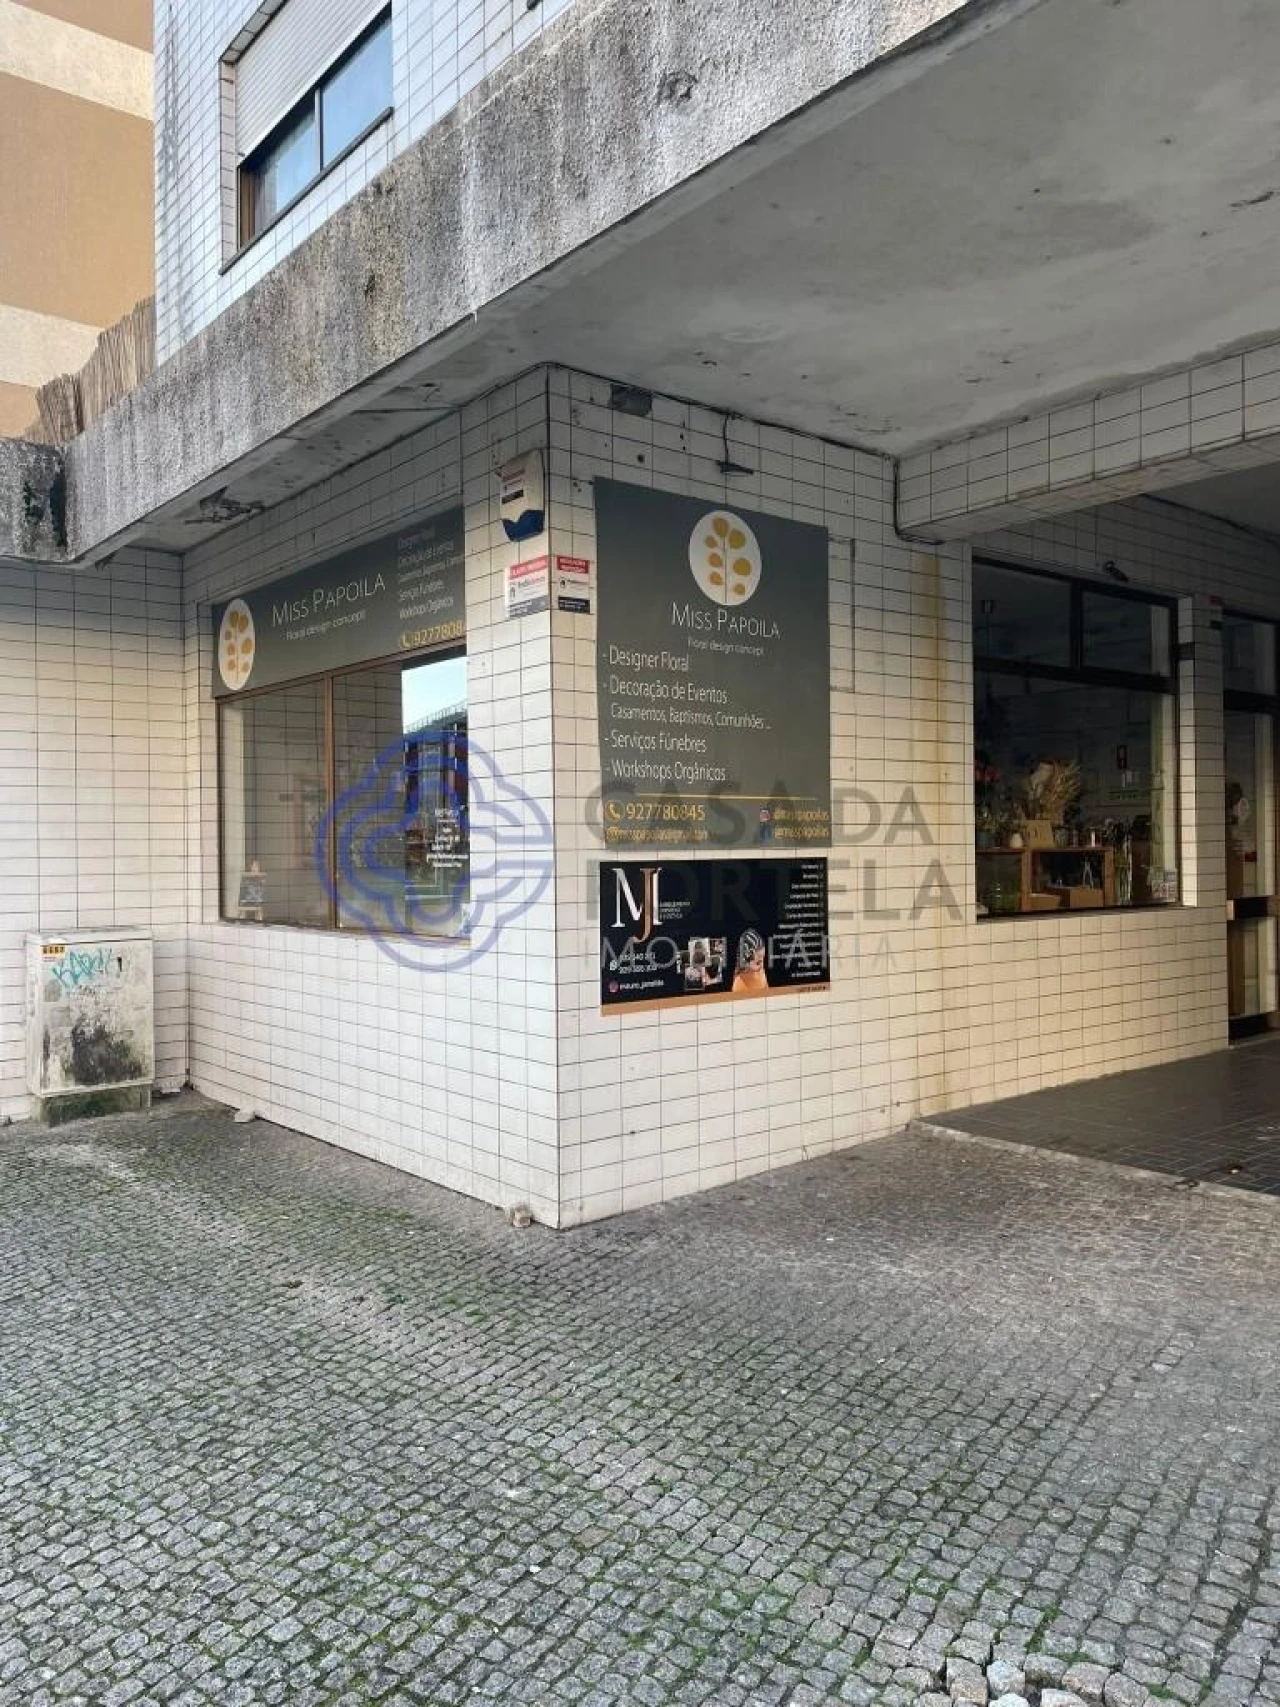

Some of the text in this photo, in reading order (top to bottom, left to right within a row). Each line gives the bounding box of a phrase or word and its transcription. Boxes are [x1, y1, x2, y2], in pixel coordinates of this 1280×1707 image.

[272, 572, 386, 628] MISS PAPOILA
[671, 601, 781, 639] MISS PAPOILA
[609, 645, 690, 672] Designer Floral
[609, 674, 728, 704] Decoração de Eventos
[611, 729, 707, 754] Serviços Fúnebres
[611, 759, 726, 784] Workshops Orgânicos
[626, 803, 706, 821] 927780845
